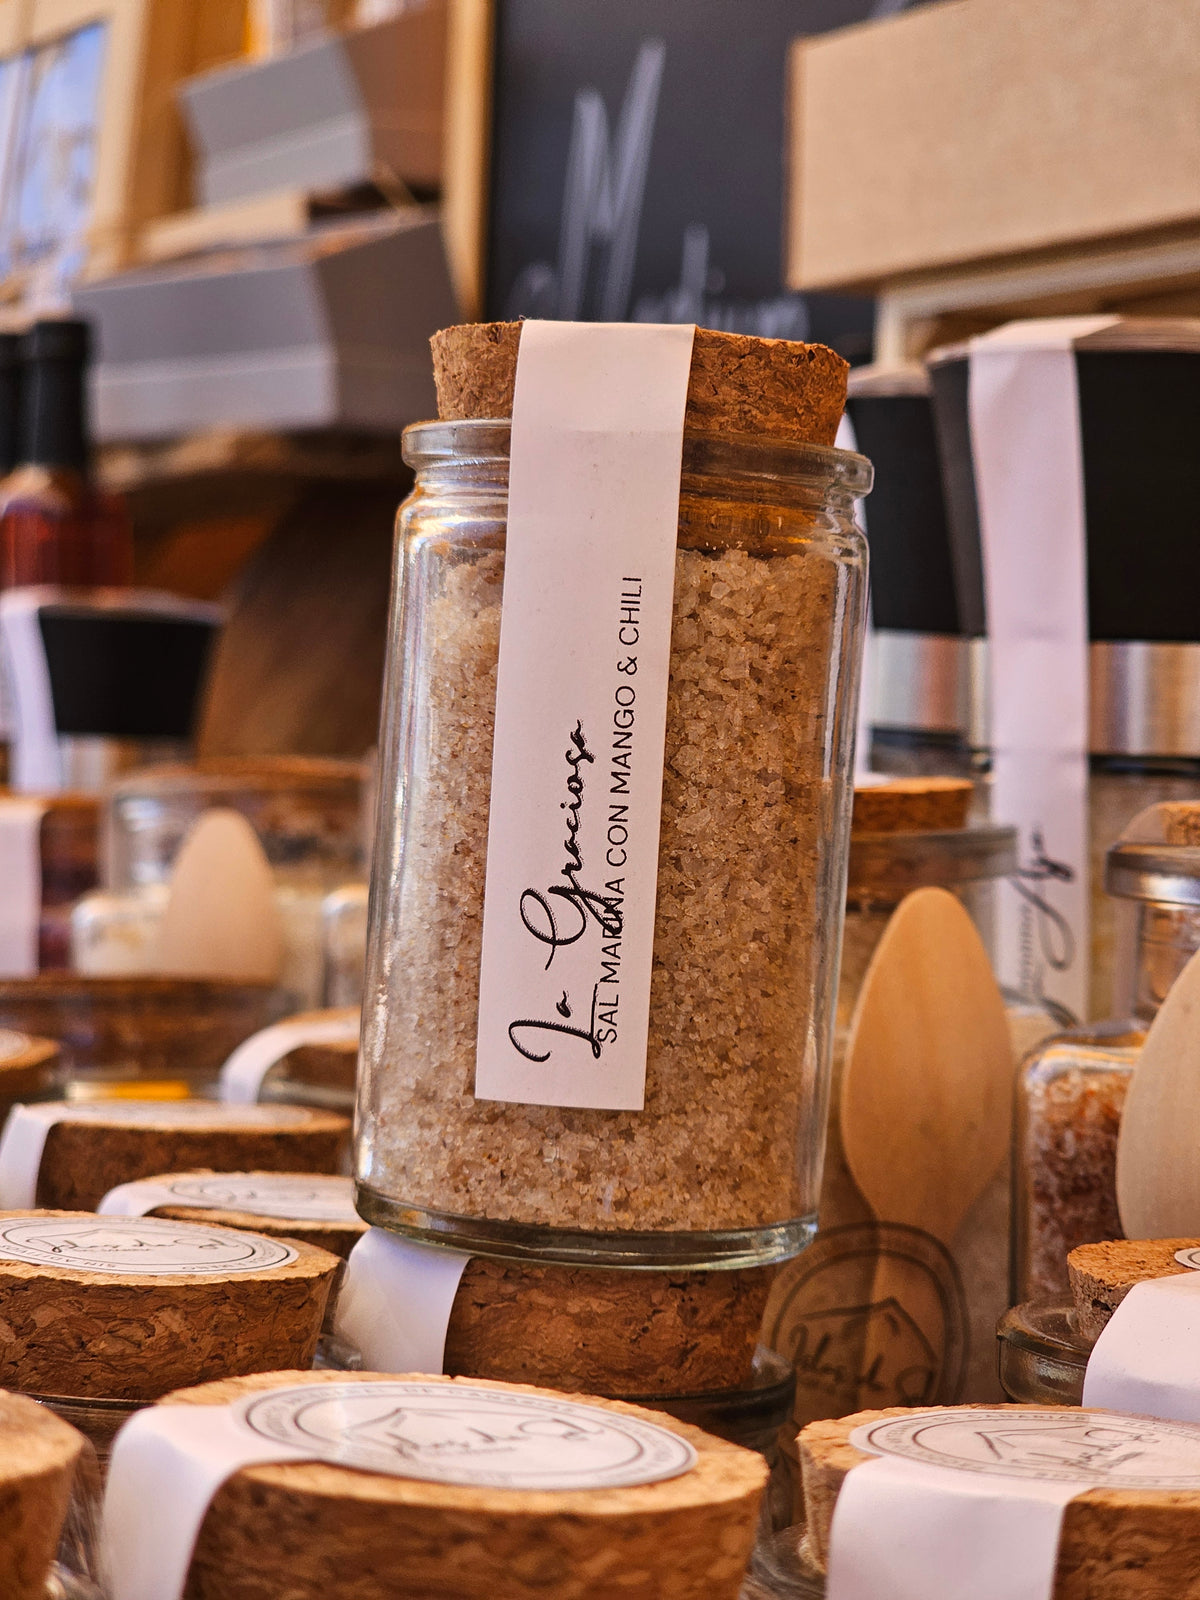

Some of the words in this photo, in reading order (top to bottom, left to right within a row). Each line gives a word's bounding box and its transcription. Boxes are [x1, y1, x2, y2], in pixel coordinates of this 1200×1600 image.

[618, 577, 642, 646] CHILI
[616, 656, 638, 676] &
[609, 685, 636, 794] MANGO
[519, 719, 624, 971] Graciosa
[606, 804, 629, 867] CON
[599, 877, 626, 984] MARINA
[508, 983, 600, 1062] La
[597, 994, 619, 1045] SAL
